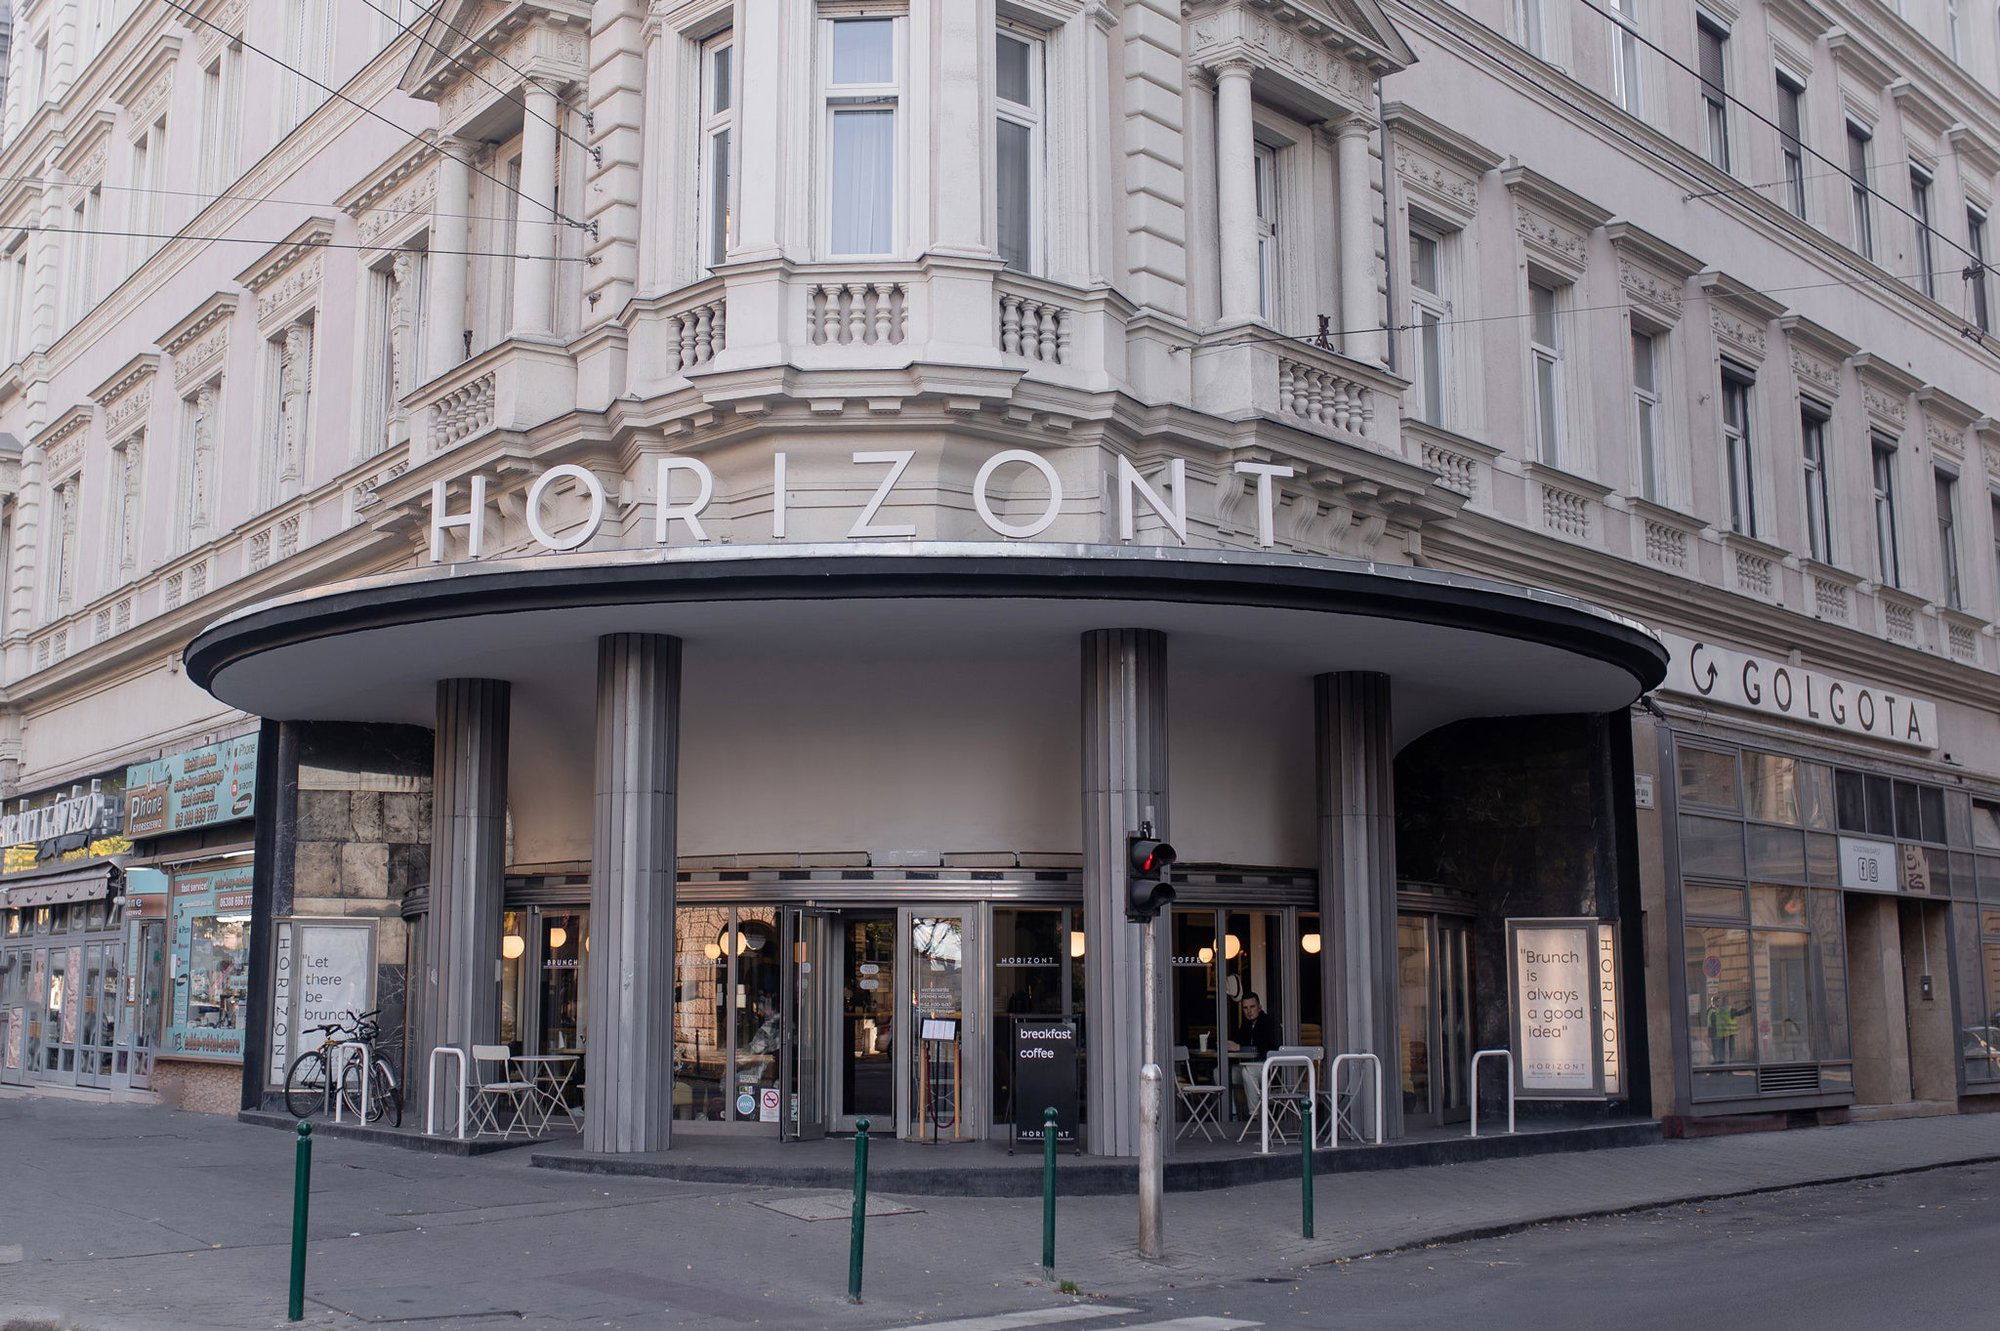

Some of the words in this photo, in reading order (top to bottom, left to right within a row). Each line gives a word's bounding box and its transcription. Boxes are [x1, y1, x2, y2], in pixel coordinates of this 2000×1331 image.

[430, 449, 1294, 563] HORIZONT
[1742, 659, 1922, 742] GOLGOTA
[302, 954, 329, 968] "Let
[1520, 948, 1579, 964] "Brunch
[305, 973, 342, 986] there
[1526, 969, 1538, 982] is
[305, 991, 323, 1003] be
[1527, 987, 1579, 1004] always
[274, 938, 290, 1073] HORIZONT
[1600, 939, 1617, 1081] HORIZONT
[1527, 1009, 1537, 1019] a
[1543, 1007, 1584, 1023] good
[1020, 1028, 1072, 1040] breakfast
[1528, 1025, 1568, 1038] idea"
[1020, 1047, 1055, 1059] coffee
